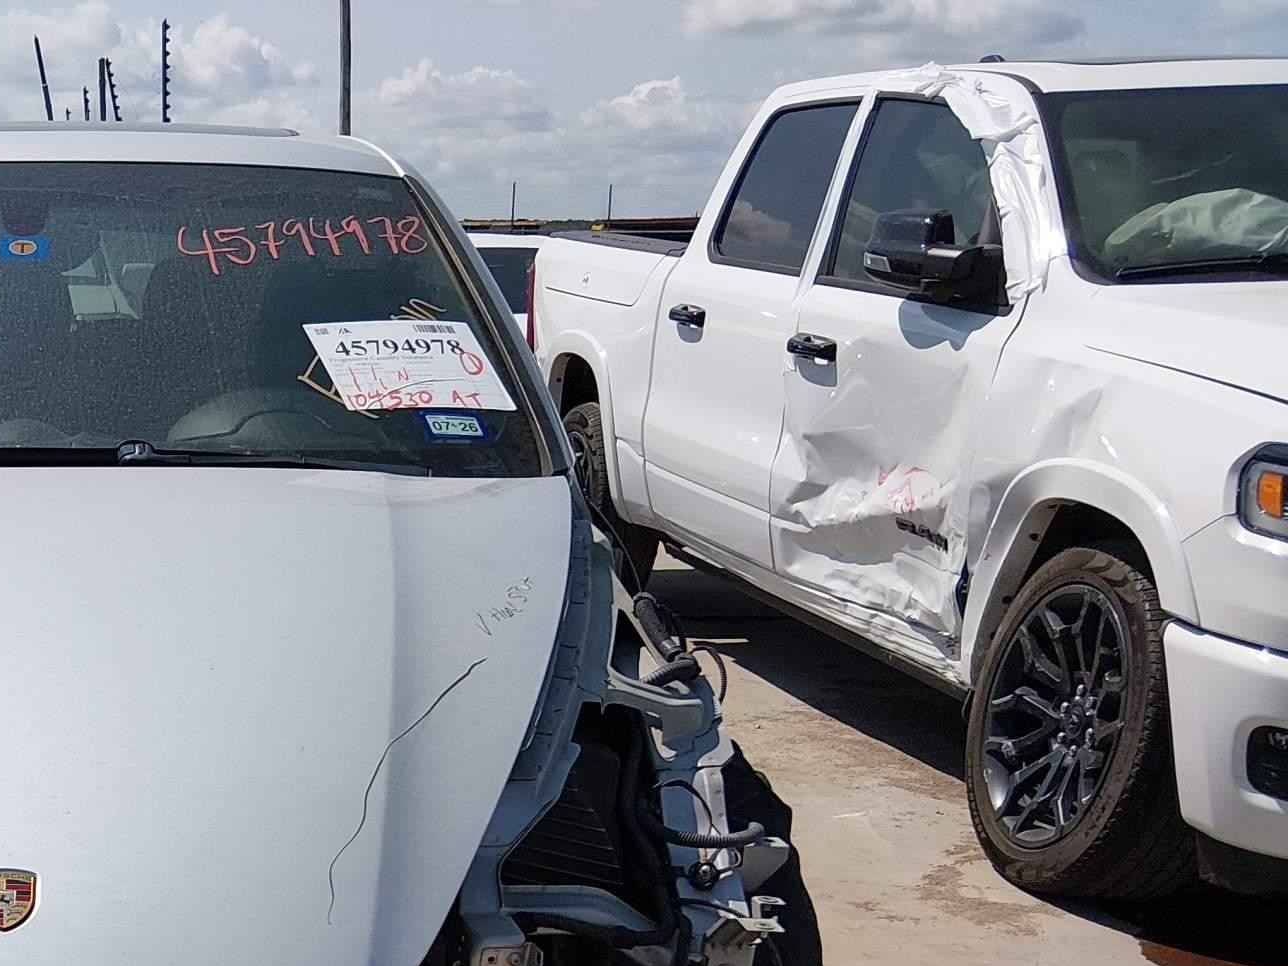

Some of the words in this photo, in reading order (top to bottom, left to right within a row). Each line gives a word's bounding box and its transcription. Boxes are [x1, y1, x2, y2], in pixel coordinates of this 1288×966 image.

[177, 215, 428, 275] 45794978
[335, 338, 465, 357] 45794978
[432, 421, 450, 431] 07
[458, 422, 478, 432] 26
